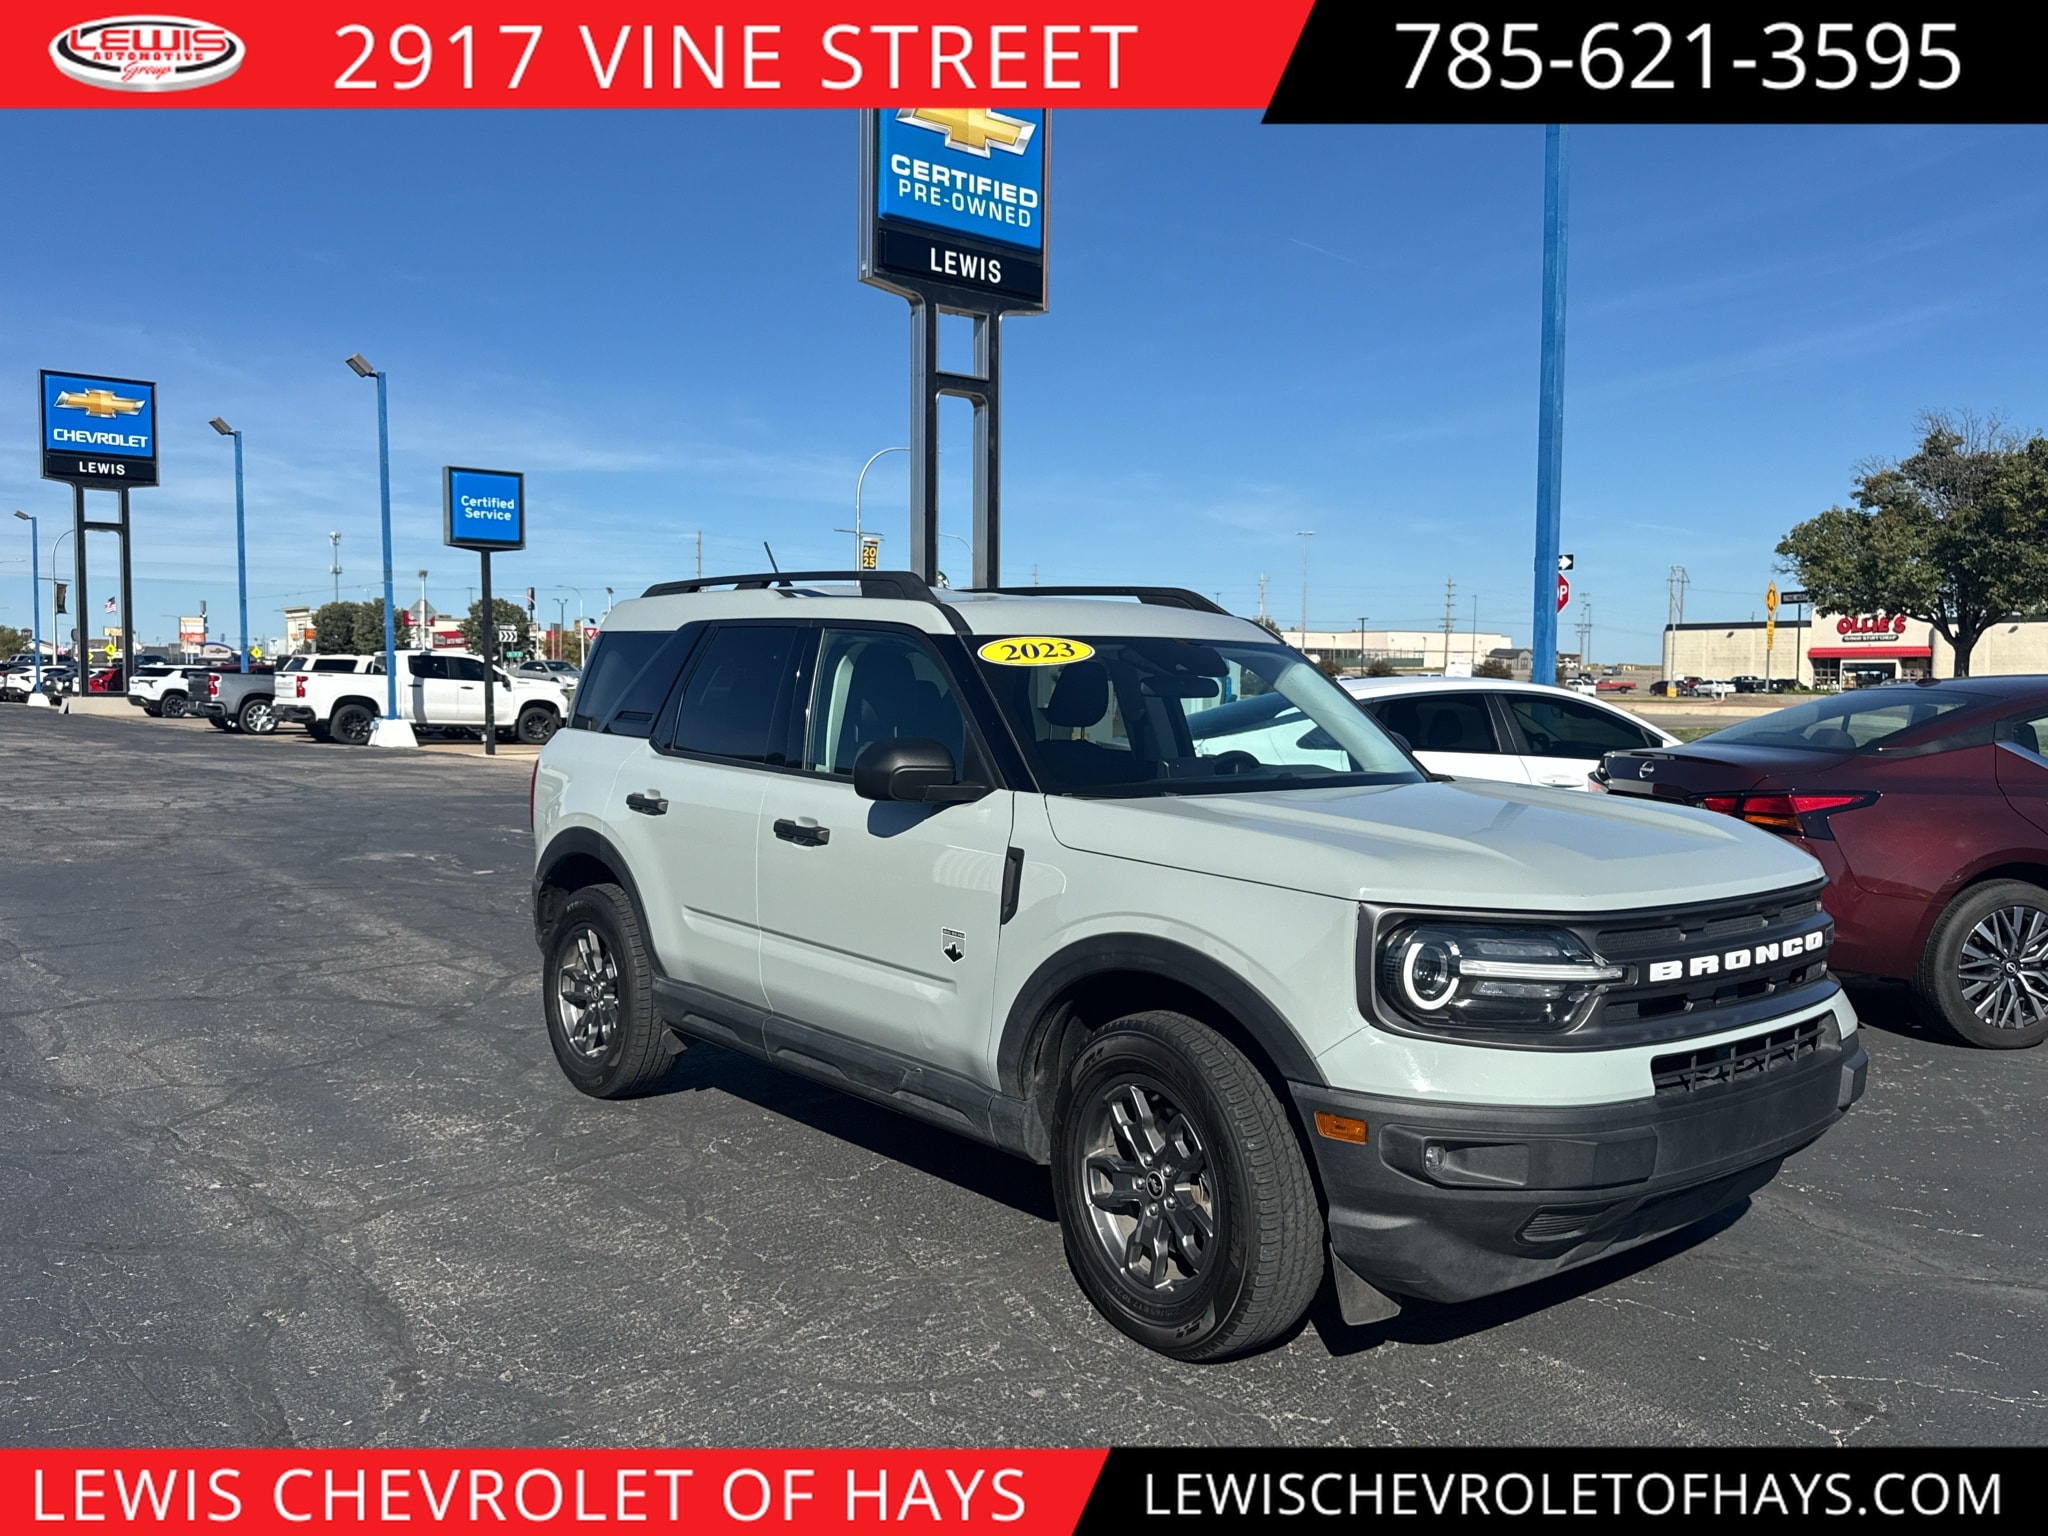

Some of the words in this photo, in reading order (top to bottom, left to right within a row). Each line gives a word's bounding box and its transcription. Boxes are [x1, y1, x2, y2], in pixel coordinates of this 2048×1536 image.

[891, 153, 1038, 209] CERTIFIED
[898, 179, 1032, 228] PRE-OWNED
[930, 247, 1002, 284] LEWIS
[53, 428, 149, 449] CHEVROLET
[79, 461, 126, 476] LEWIS
[460, 495, 515, 510] Certified
[464, 507, 512, 521] Service
[863, 546, 876, 557] 20
[863, 557, 876, 568] 25
[1837, 615, 1907, 635] OLLIES
[1001, 642, 1076, 661] 2023
[1649, 930, 1824, 983] BRONCO
